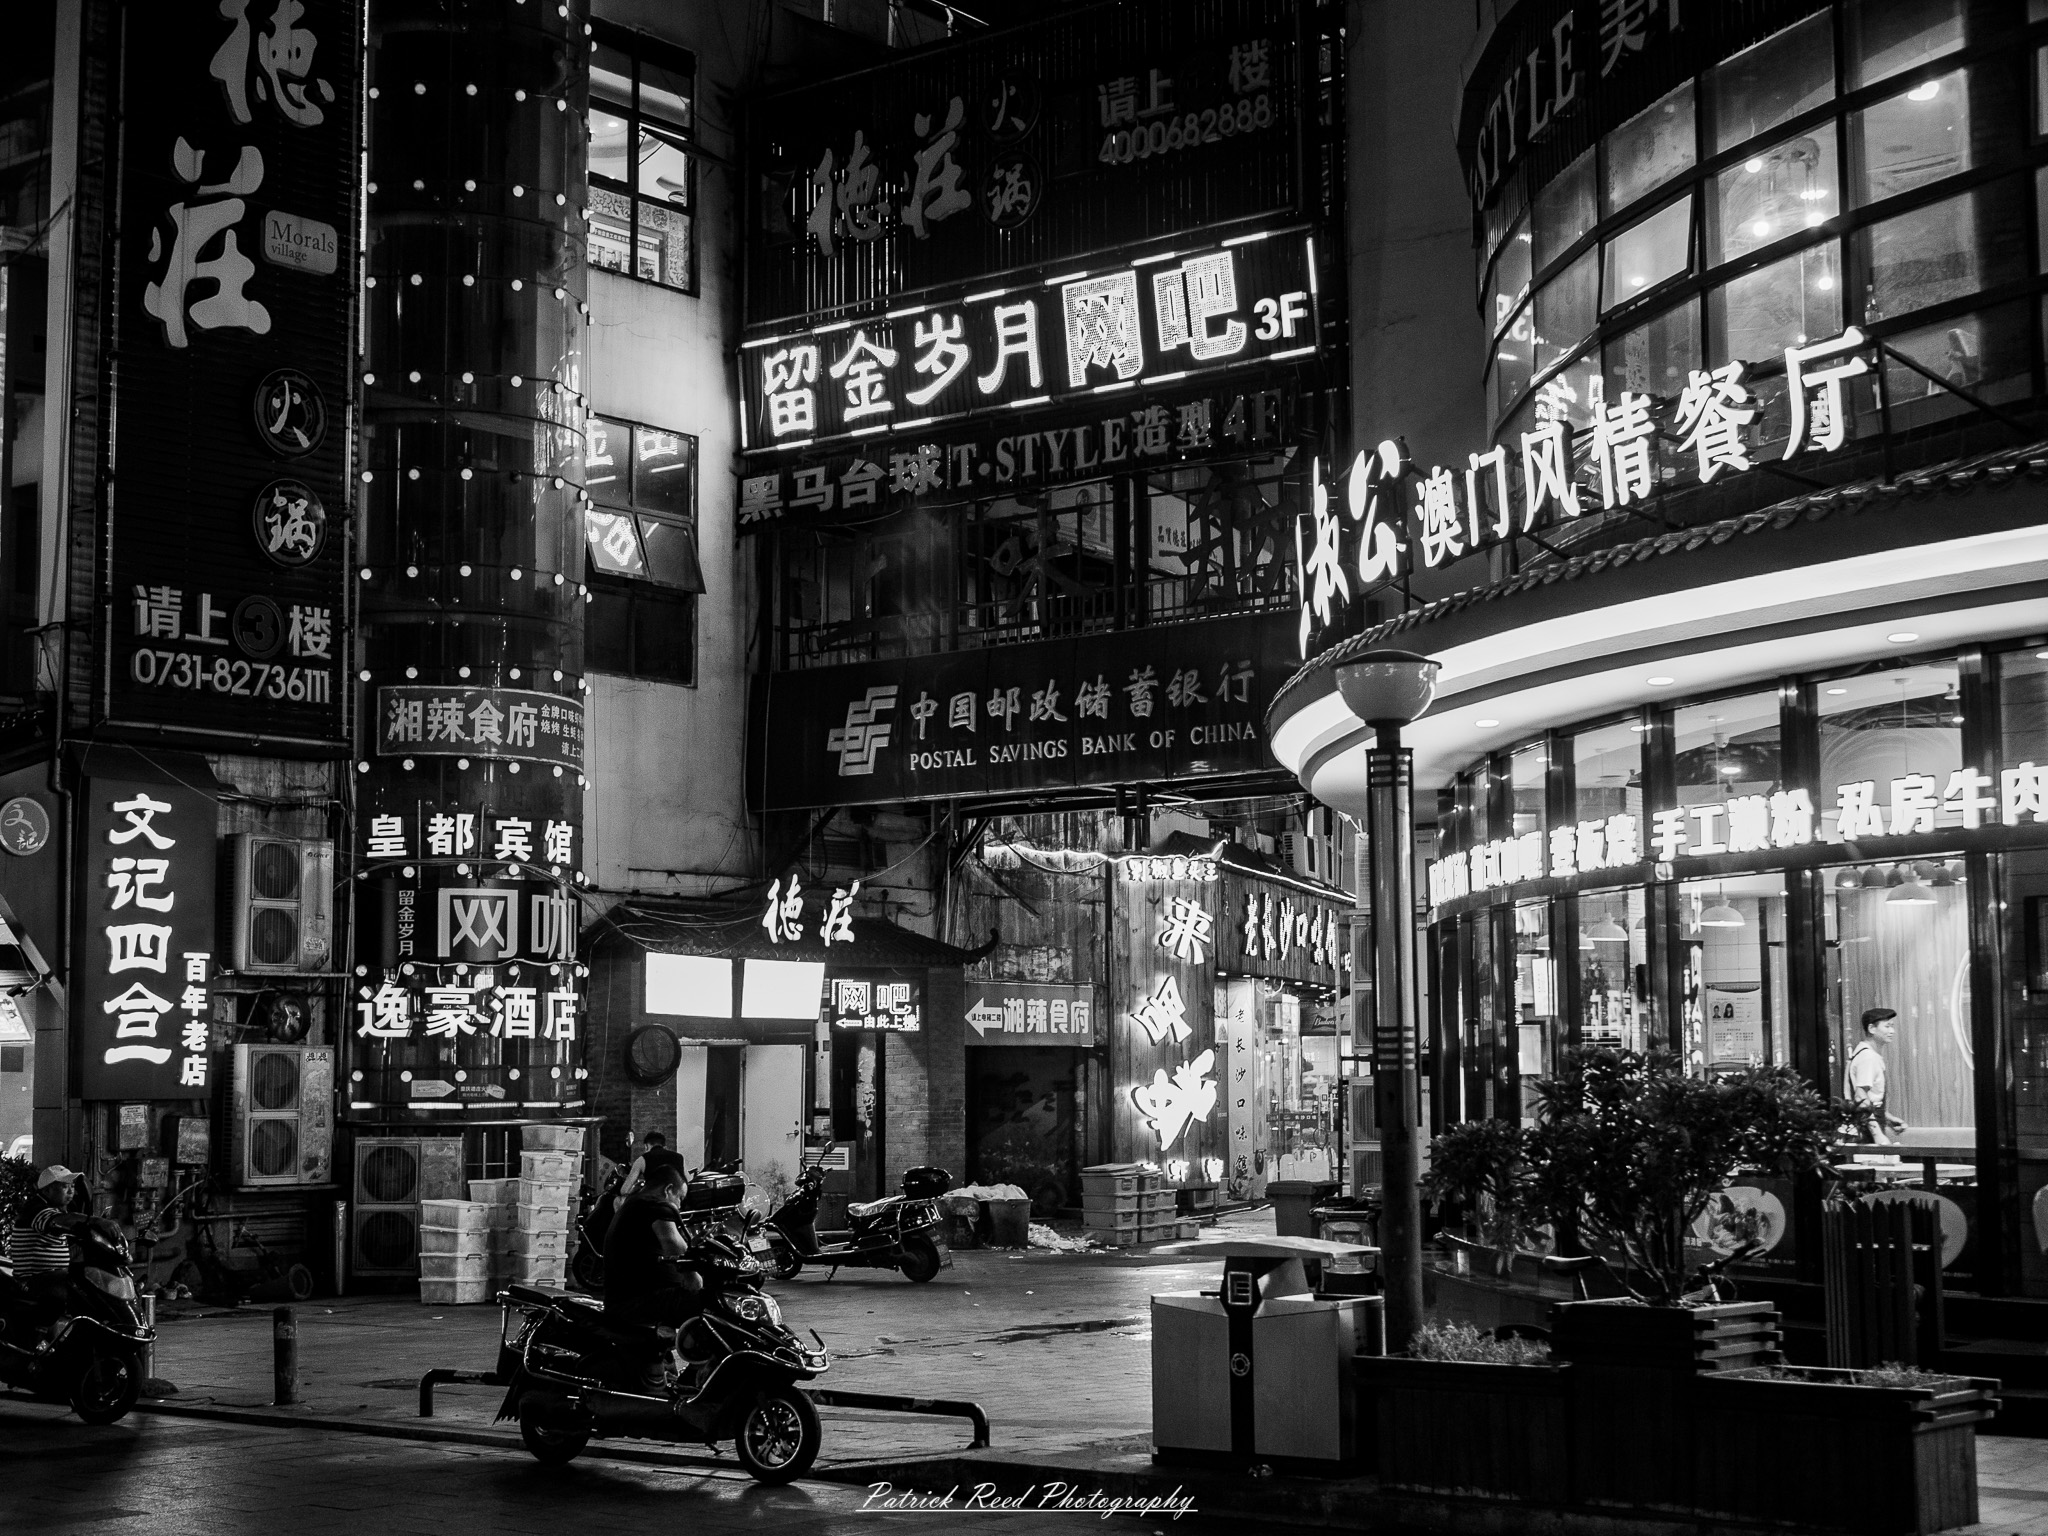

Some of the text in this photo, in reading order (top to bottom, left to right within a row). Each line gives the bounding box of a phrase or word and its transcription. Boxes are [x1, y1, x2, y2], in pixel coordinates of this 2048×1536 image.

[271, 219, 335, 254] Morals
[271, 243, 308, 264] village
[763, 251, 1308, 438] 留金岁月网吧 3F
[1415, 327, 1871, 570] 澳门风情餐厅
[737, 444, 944, 524] 黑马台球
[131, 648, 331, 704] 0731-82736111
[909, 657, 1256, 740] 中国邮政储蓄银行
[387, 697, 538, 749] 湘辣食府
[909, 720, 1257, 771] POSTAL SAVINGS BANK OF CHINA
[1836, 761, 2048, 842] 私房牛肉
[366, 813, 575, 865] 皇都宾馆
[103, 793, 176, 1065] 文记四合一
[397, 890, 416, 956] 留金岁月
[437, 888, 577, 958] 网咖
[180, 952, 210, 1087] 百年老店
[357, 984, 579, 1041] 逸豪酒店
[836, 980, 913, 1011] 网吧
[863, 1014, 917, 1031] 由此上楼
[1003, 997, 1090, 1034] 湘辣食府
